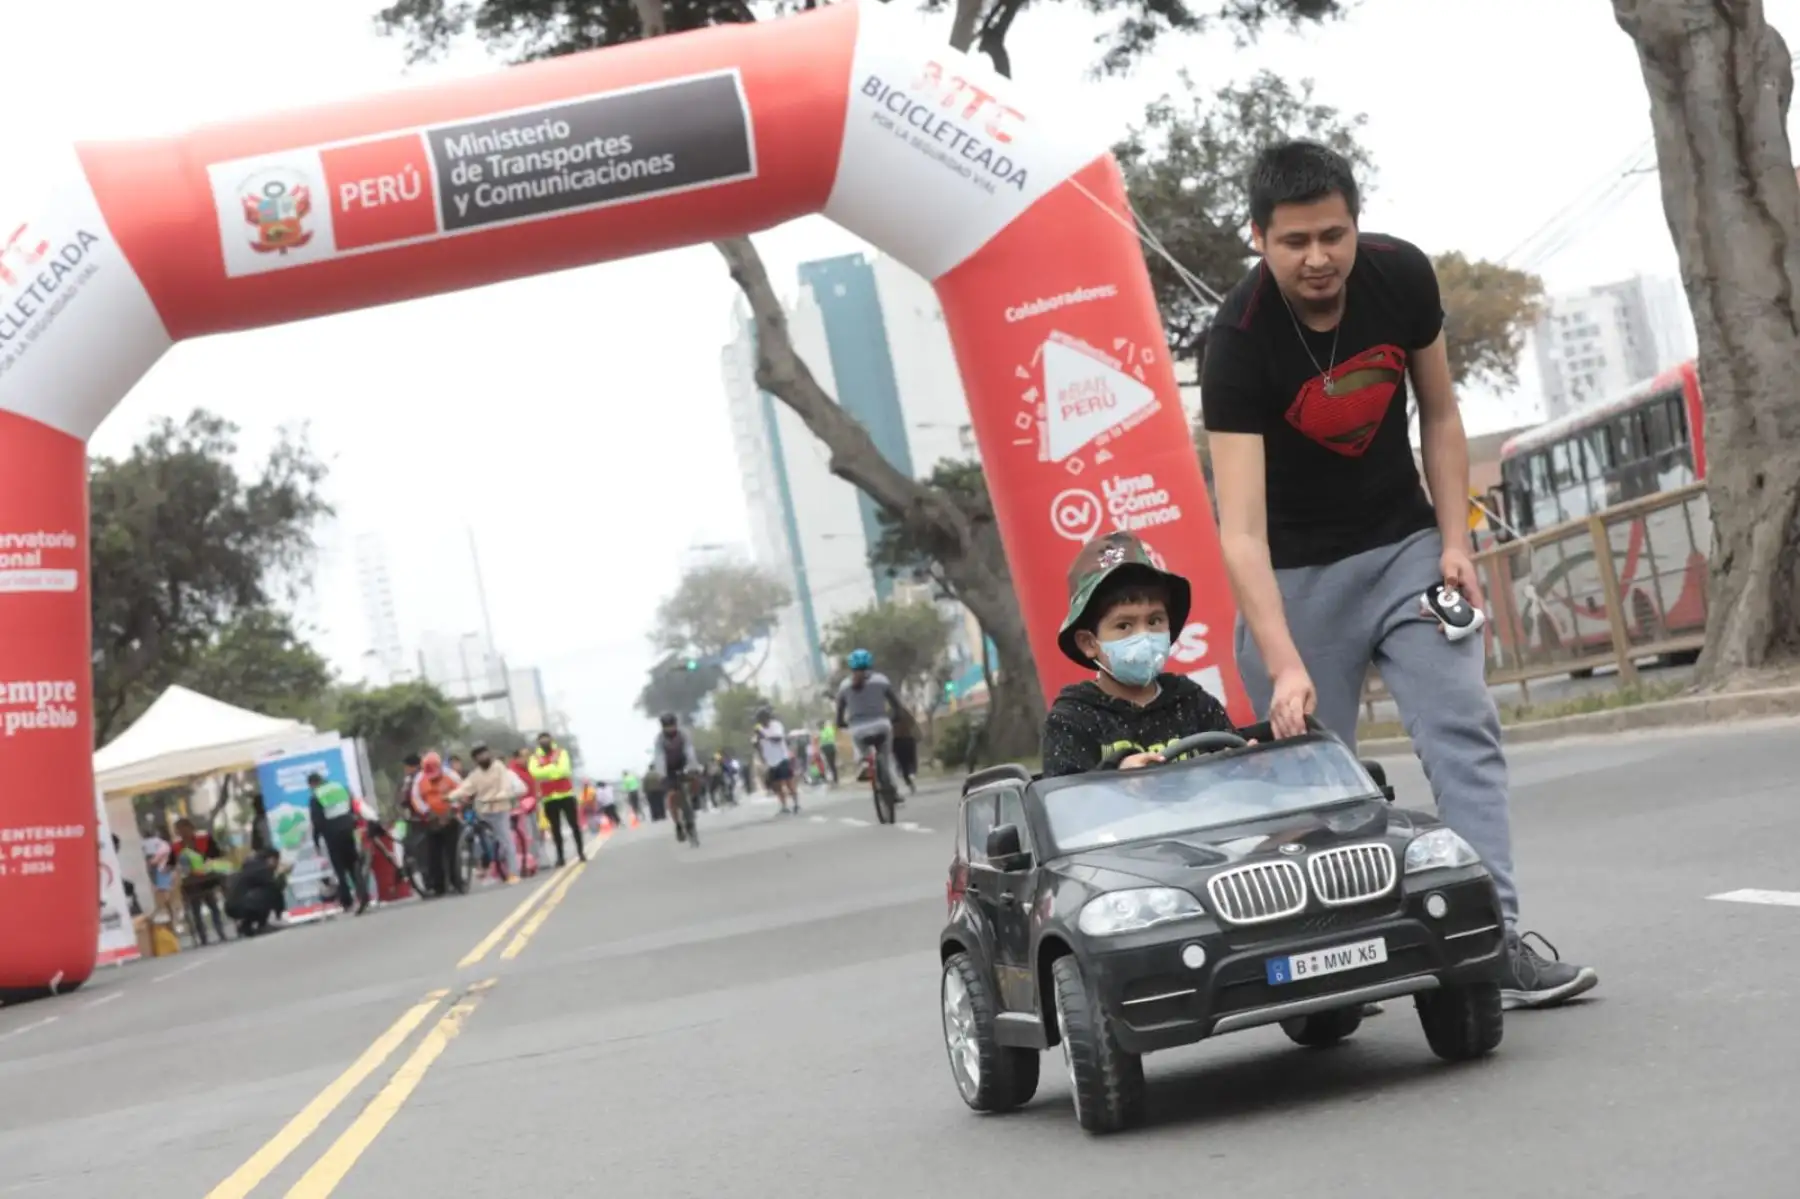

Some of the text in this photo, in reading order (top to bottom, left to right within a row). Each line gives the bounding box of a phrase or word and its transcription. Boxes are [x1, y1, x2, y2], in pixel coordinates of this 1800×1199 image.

[443, 117, 571, 160] Ministerio
[860, 75, 1028, 191] BICICLETEADA
[451, 132, 633, 187] de Transportes
[339, 164, 421, 211] PERÚ
[453, 153, 676, 216] y Comunicaciones
[1101, 473, 1154, 500] Lima
[1111, 505, 1182, 532] Vamos
[5, 703, 78, 737] pueblo
[1324, 950, 1353, 970] MW
[1358, 944, 1377, 963] X5
